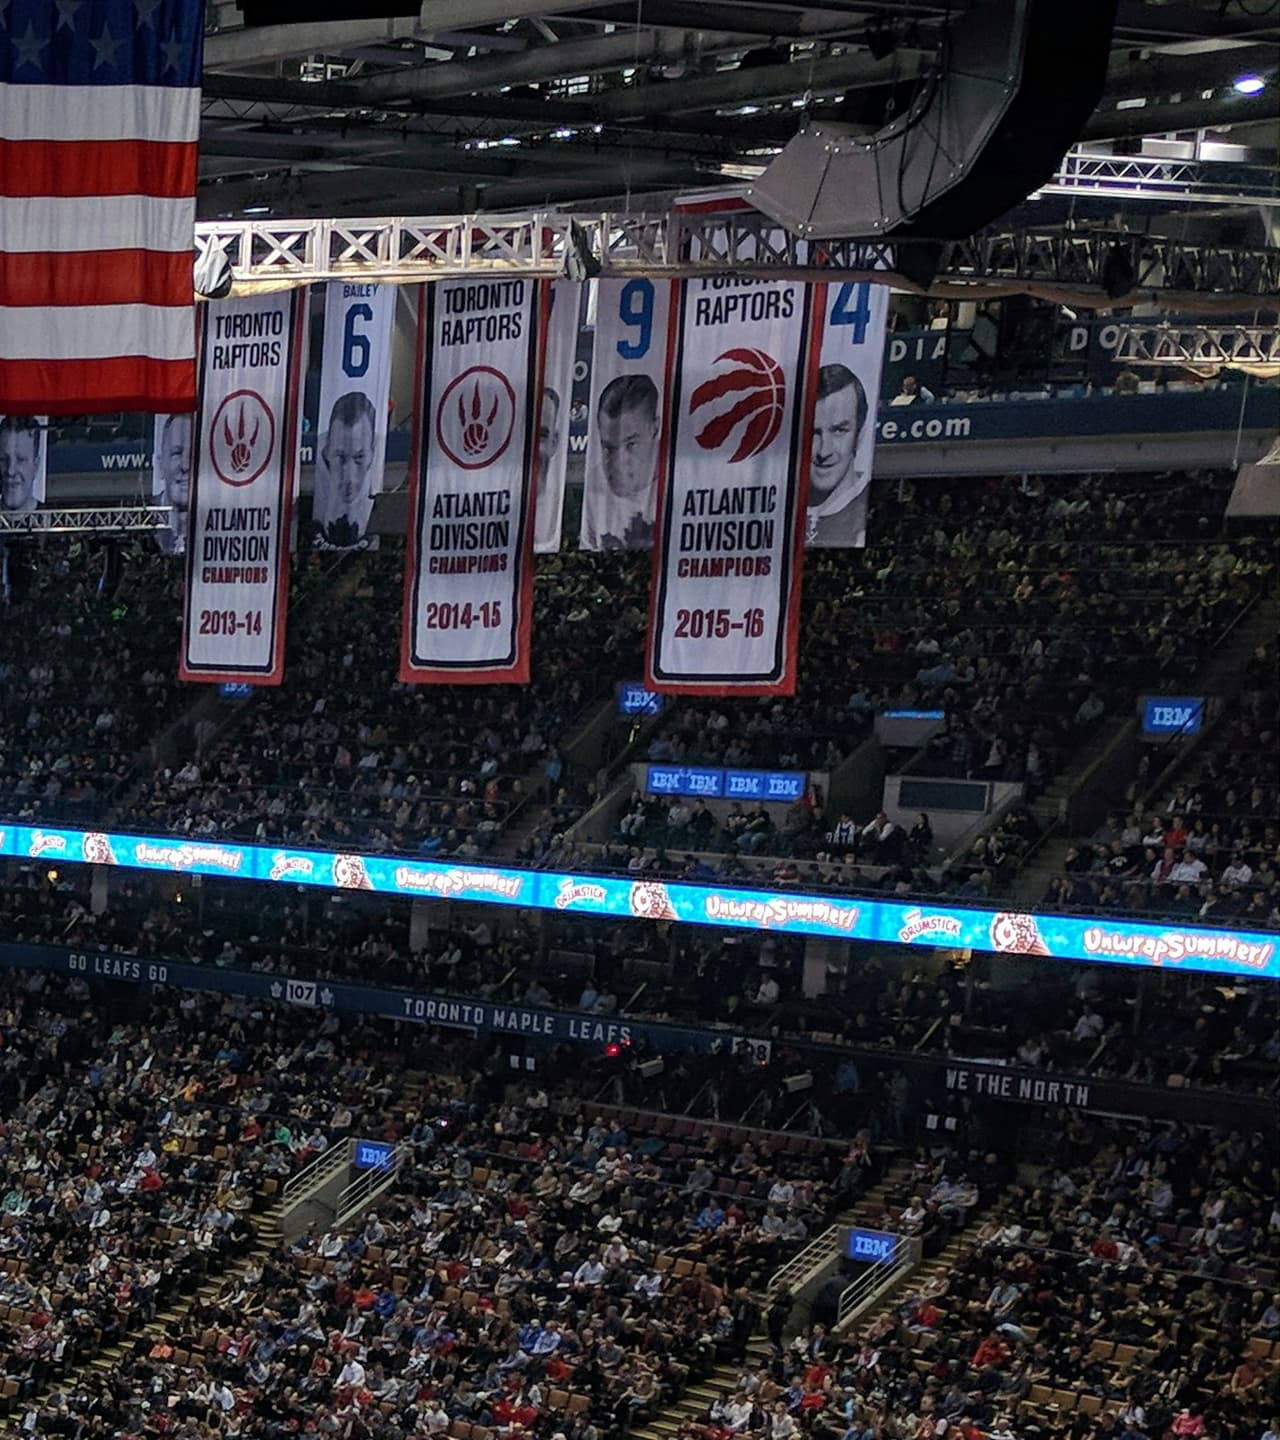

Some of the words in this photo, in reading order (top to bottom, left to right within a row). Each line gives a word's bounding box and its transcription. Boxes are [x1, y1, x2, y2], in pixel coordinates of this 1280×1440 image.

[342, 284, 380, 298] BAILEY
[443, 280, 525, 315] TORONTO
[616, 278, 655, 360] 9
[695, 289, 795, 326] RAPTORS
[829, 281, 871, 345] 4
[215, 311, 283, 339] TORONTO
[441, 312, 523, 347] RAPTORS
[342, 303, 373, 379] 6
[212, 342, 282, 370] RAPTORS
[432, 489, 511, 519] ATLANTIC
[683, 485, 777, 517] ATLANTIC
[205, 506, 271, 532] ATLANTIC
[202, 536, 269, 562] DIVISION
[430, 520, 509, 551] DIVISION
[679, 519, 774, 553] DIVISION
[201, 566, 269, 585] CHAMPIONS
[429, 553, 508, 574] CHAMPIONS
[677, 556, 771, 579] CHAMPIONS
[199, 610, 262, 636] 2013-14
[426, 601, 502, 629] 2014-15
[674, 607, 764, 639] 2015-16
[1151, 706, 1192, 726] IBM
[652, 773, 681, 788] IBM
[689, 775, 718, 791] IBM
[730, 777, 759, 793] IBM
[768, 779, 798, 795] IBM
[900, 916, 959, 942] DRUMSTICK
[69, 953, 87, 970] GO
[95, 957, 140, 978] LEAFS
[148, 965, 168, 982] GO
[287, 983, 315, 1000] 107
[403, 997, 484, 1026] TORONTO
[493, 1009, 554, 1034] MAPLE
[569, 1021, 631, 1044] LEAFS
[946, 1069, 968, 1090] WE
[975, 1073, 1012, 1097] THE
[1019, 1079, 1089, 1107] NORTH
[361, 1147, 387, 1166] IBM
[854, 1236, 889, 1257] IBM
